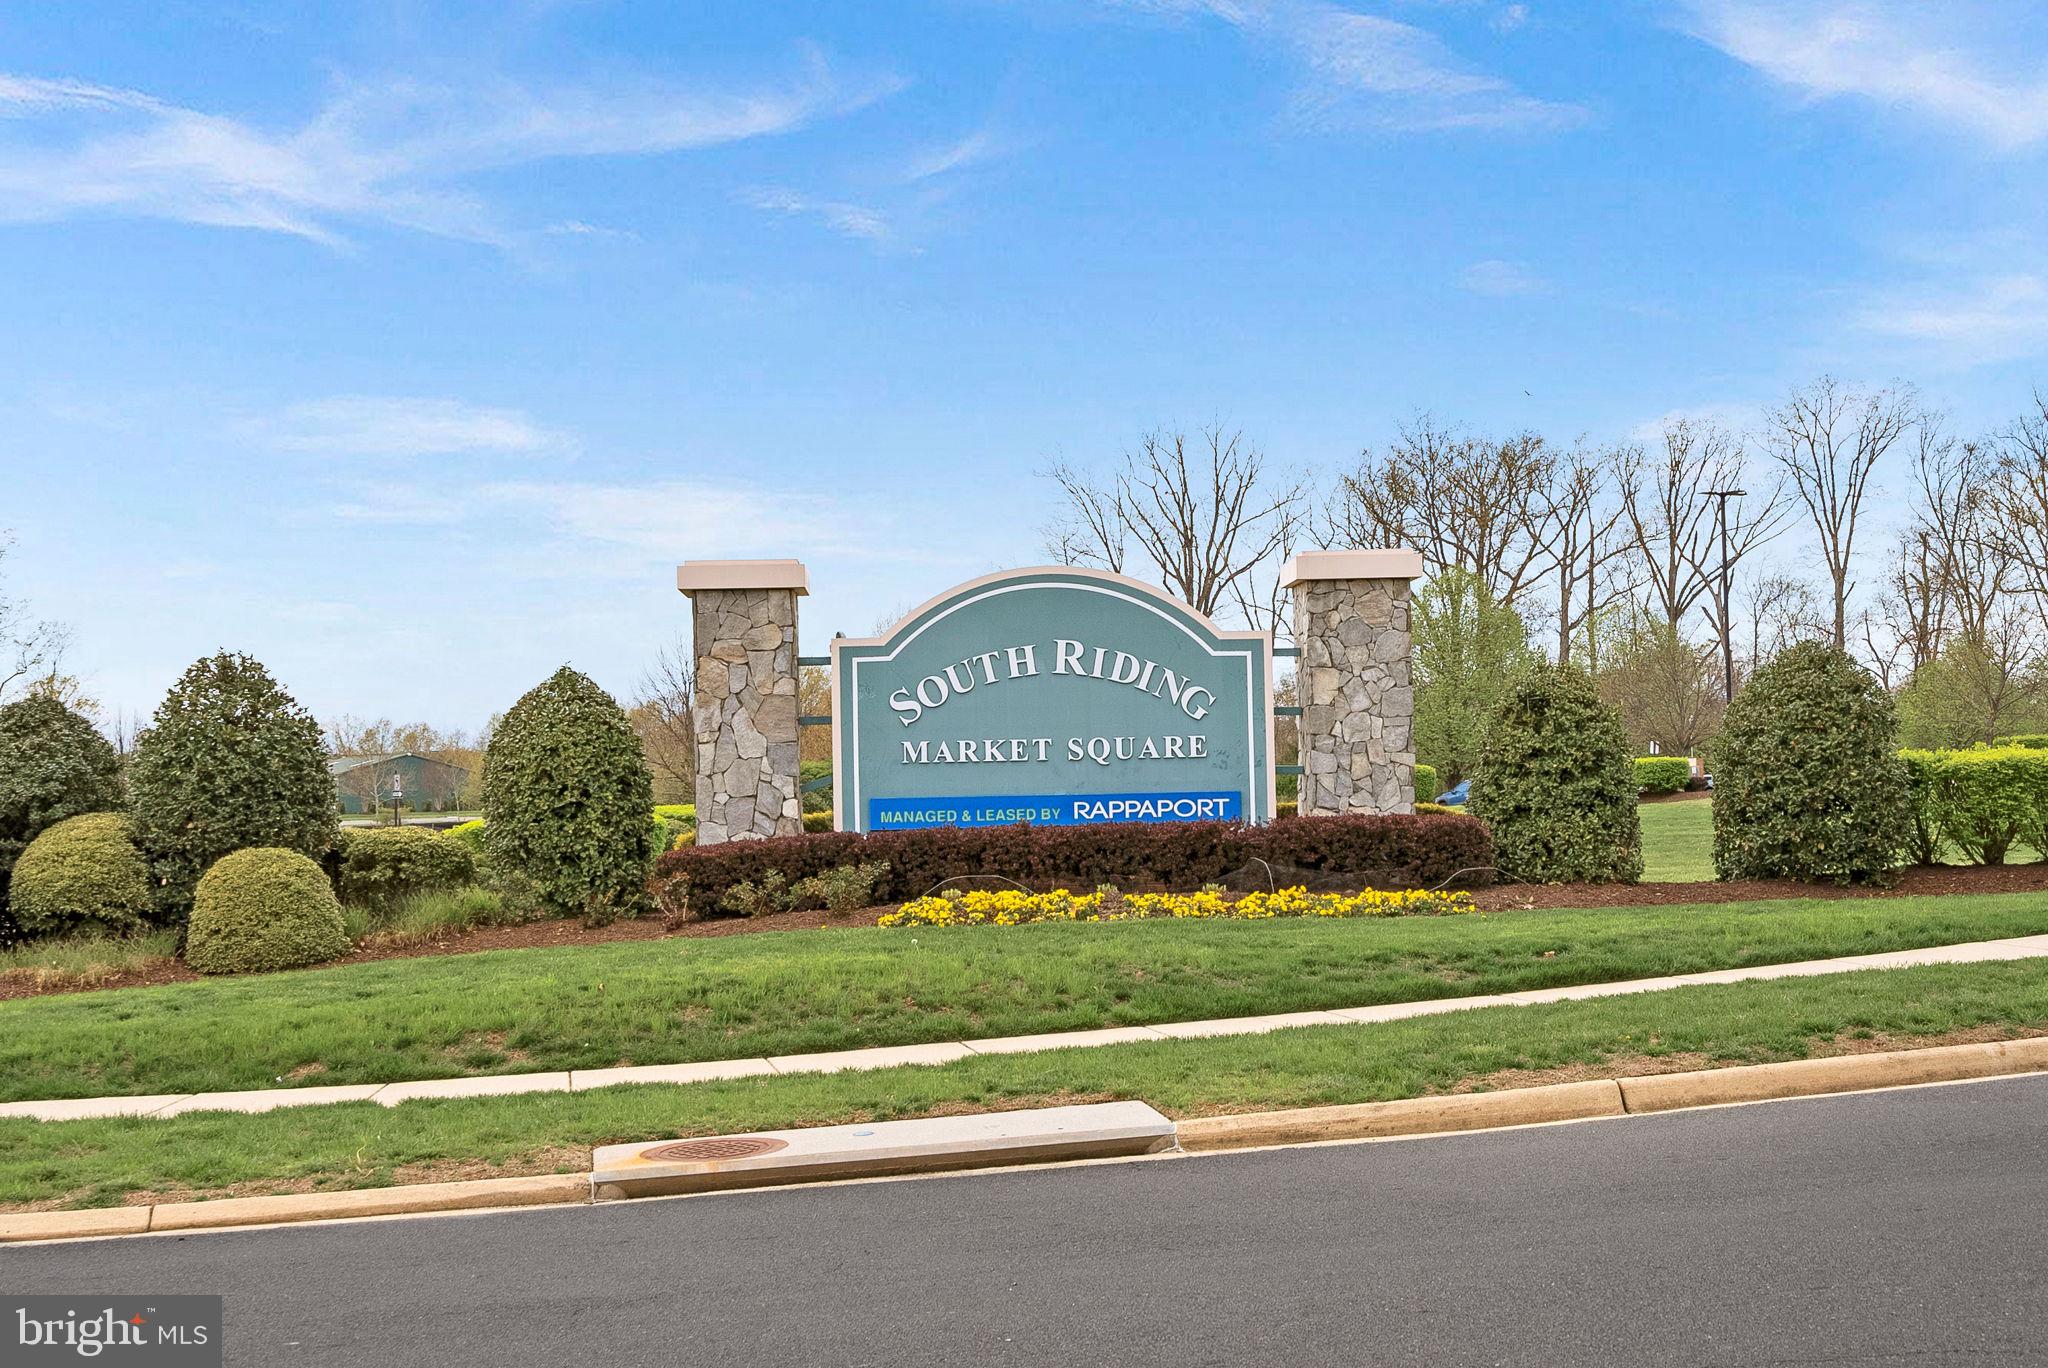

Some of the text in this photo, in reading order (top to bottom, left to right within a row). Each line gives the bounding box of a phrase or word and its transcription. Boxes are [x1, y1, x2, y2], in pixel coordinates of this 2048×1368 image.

[889, 639, 1217, 728] SOUTH RIDING
[900, 735, 1208, 766] MARKET SQUARE
[880, 798, 1230, 824] MANAGED & LEASED BY RAPPAPORT
